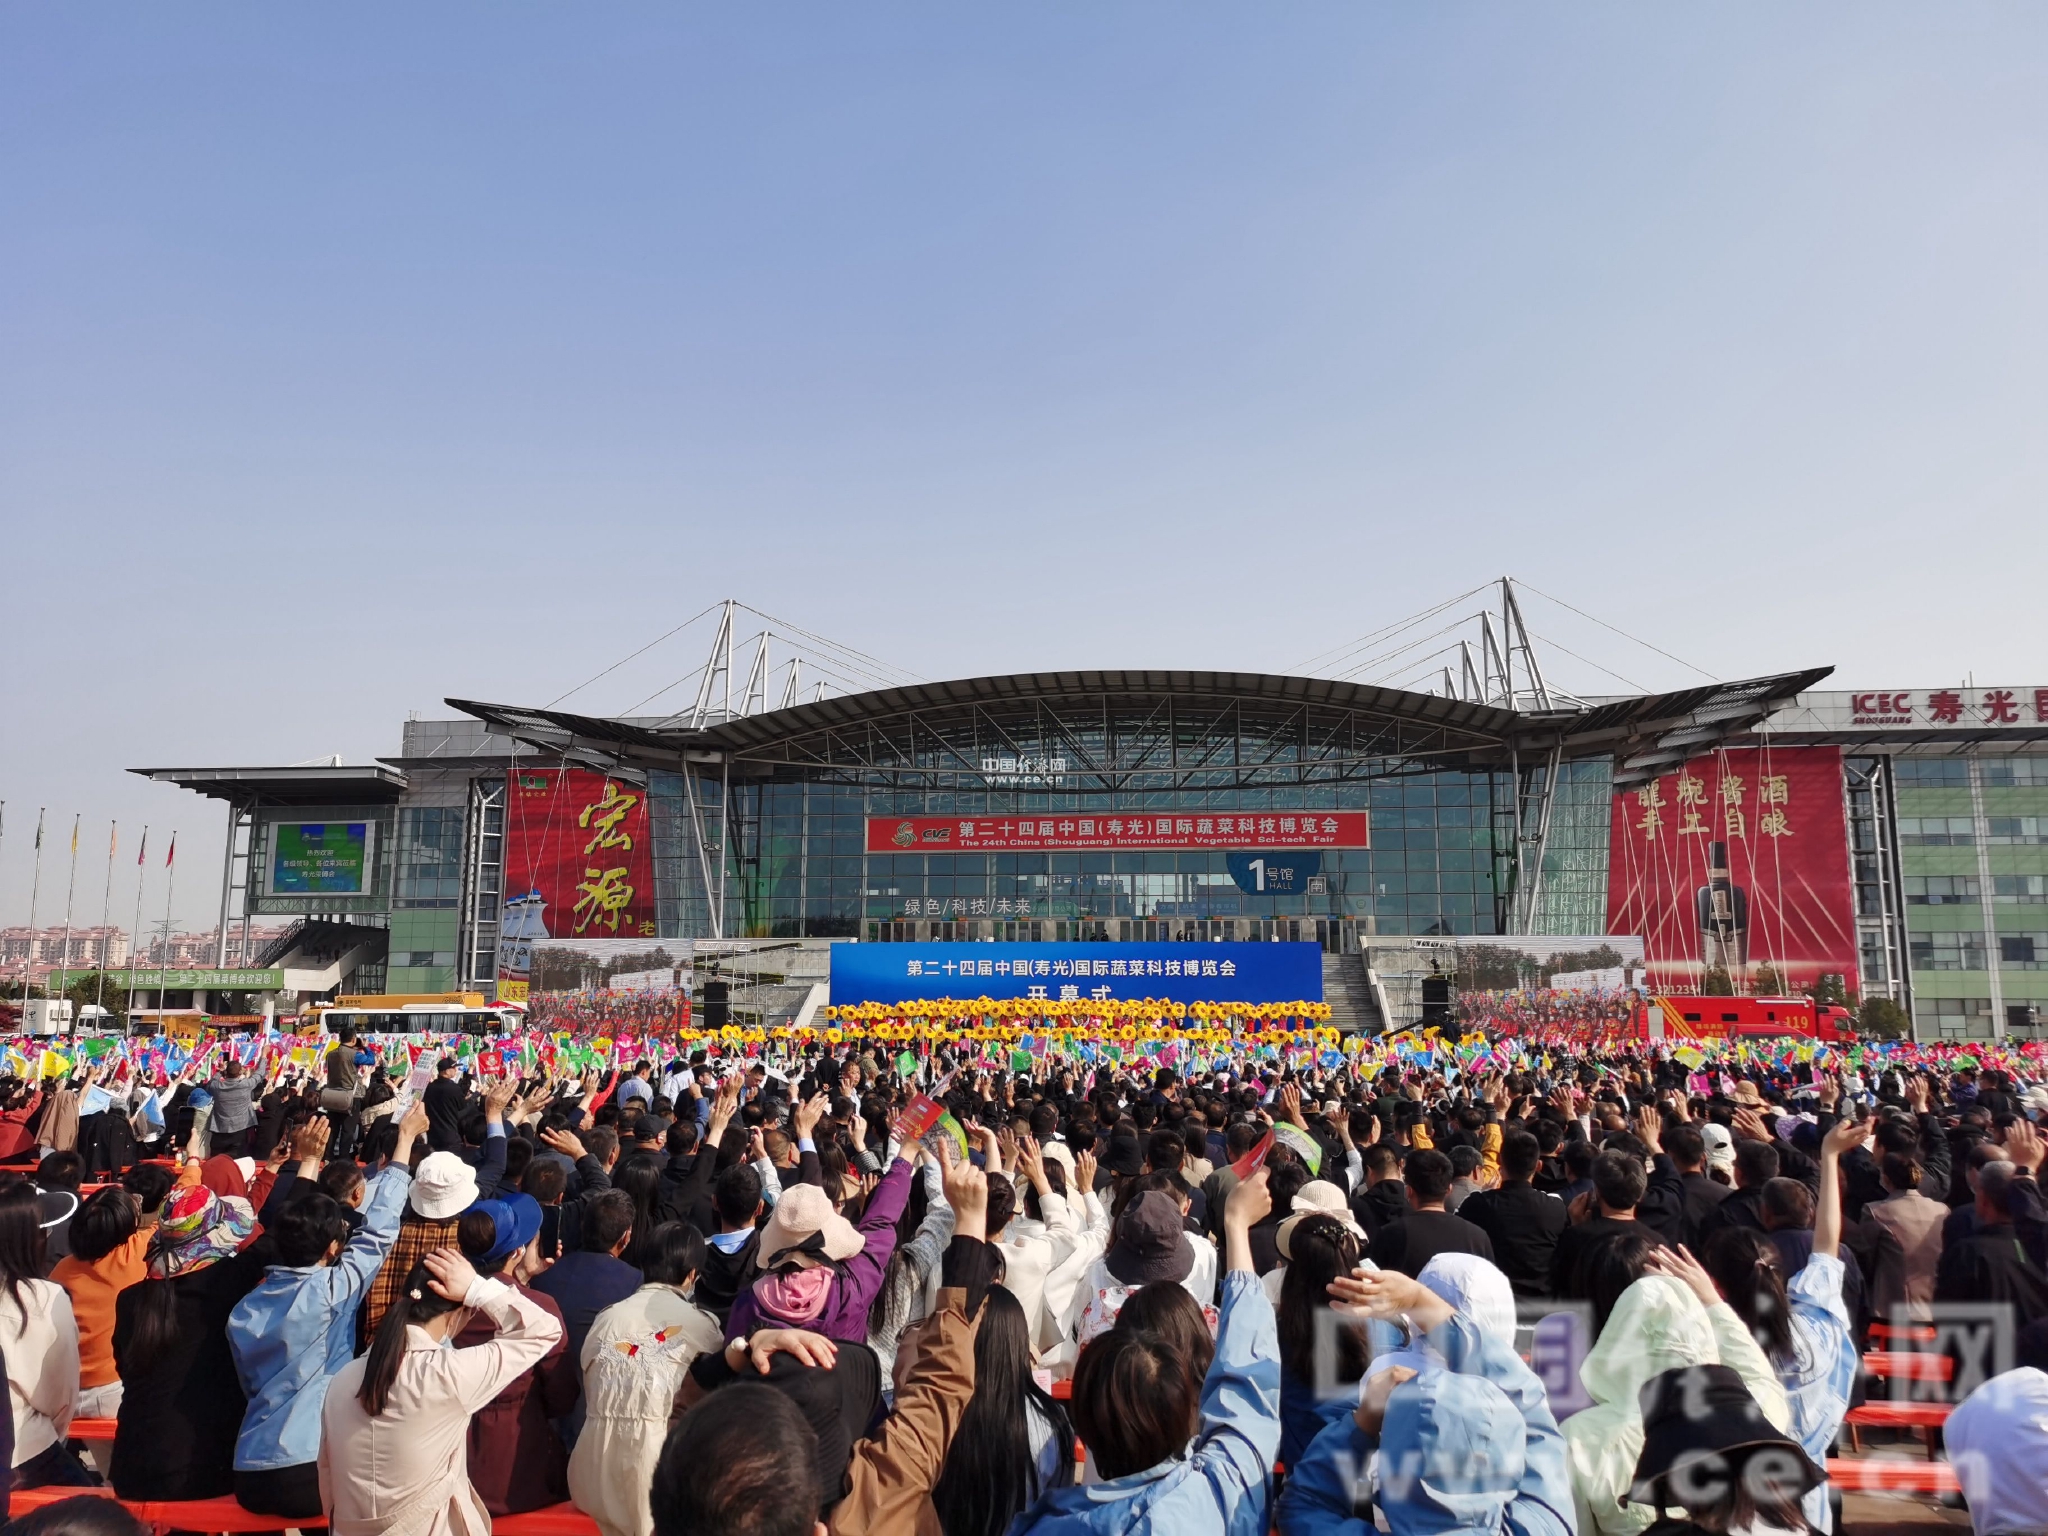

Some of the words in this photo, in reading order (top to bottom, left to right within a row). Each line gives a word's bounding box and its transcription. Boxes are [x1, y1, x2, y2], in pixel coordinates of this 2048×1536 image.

[1852, 693, 1911, 714] ICEC
[959, 817, 1339, 837] 第二十四届中国(寿光)国际蔬菜科技博览会
[1009, 838, 1040, 846] China
[1044, 838, 1113, 847] (Shouguang)
[1117, 837, 1188, 845] International
[1195, 836, 1251, 845] Vegetable
[1313, 835, 1335, 843] Fair
[572, 783, 640, 934] 宏源
[1248, 859, 1265, 890] 1
[1266, 868, 1293, 881] 号馆
[904, 897, 1031, 916] 绿色/科技/未来
[907, 959, 1237, 978] 第二十四届中国(寿光)国际蔬菜科技博览会
[1027, 984, 1112, 1002] 开幕式
[1785, 1015, 1808, 1029] 119
